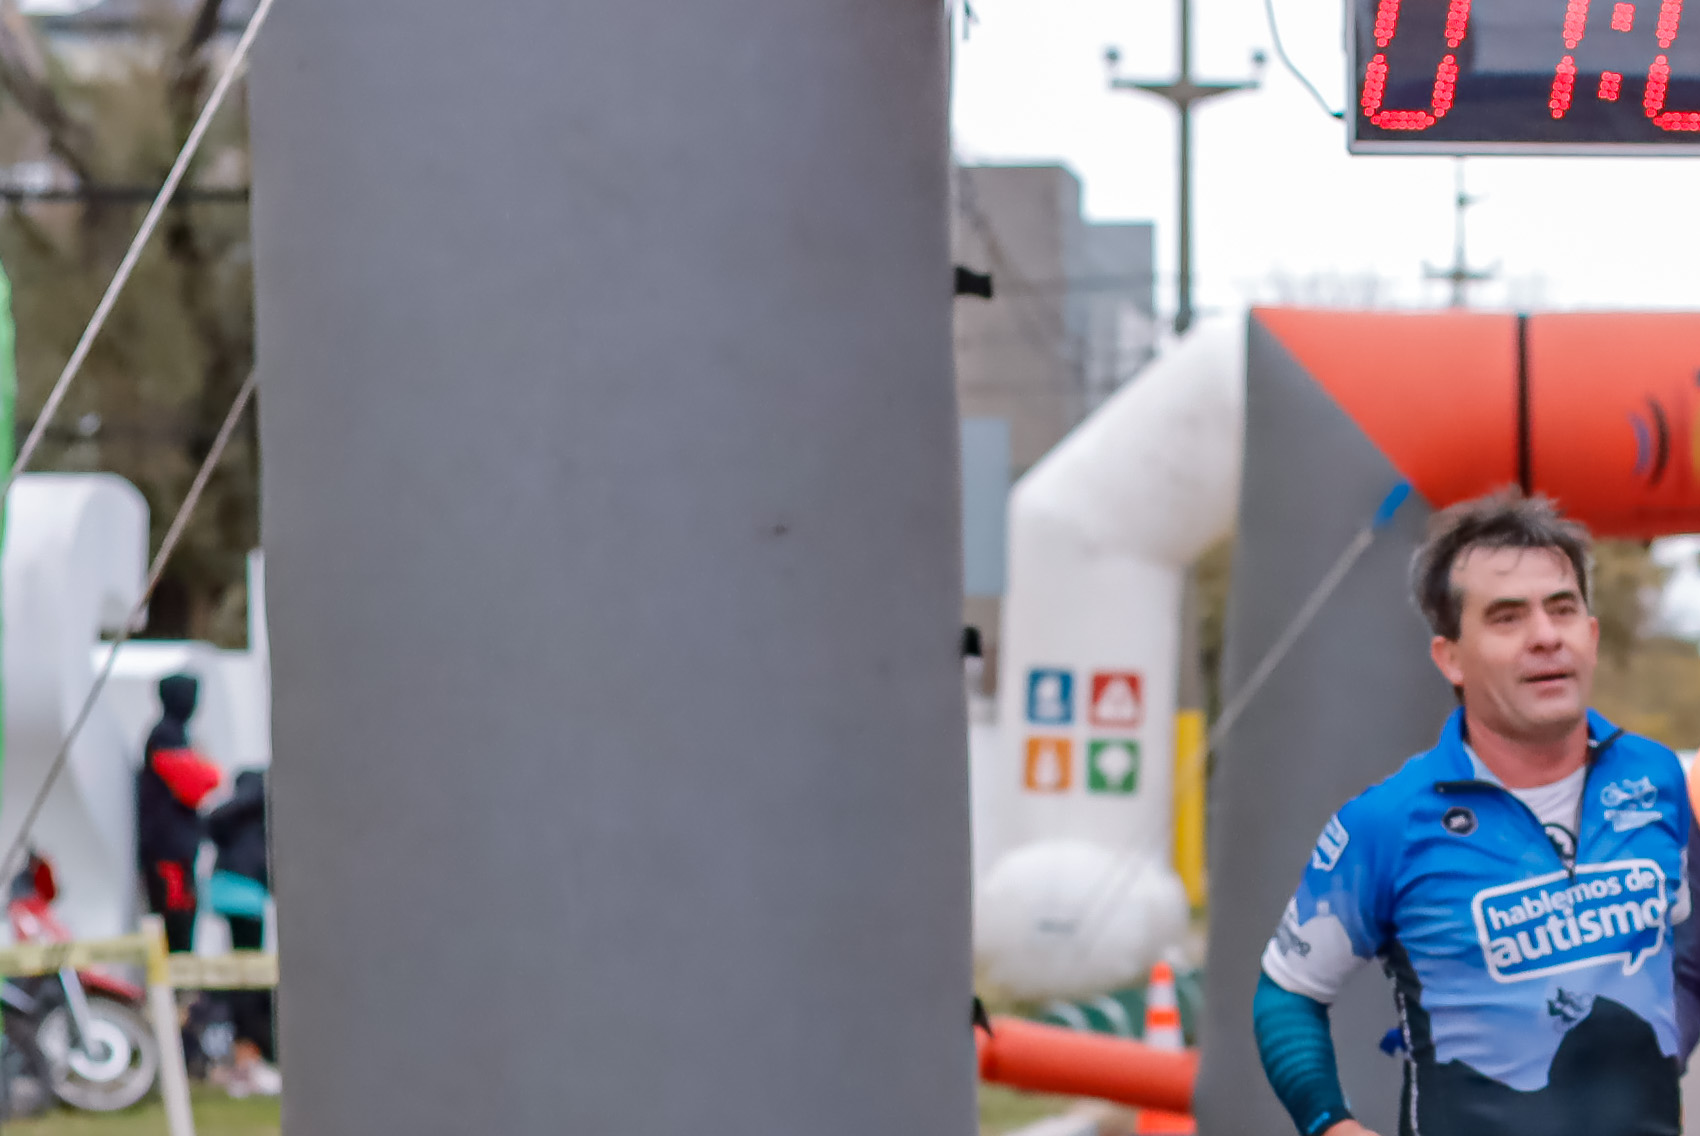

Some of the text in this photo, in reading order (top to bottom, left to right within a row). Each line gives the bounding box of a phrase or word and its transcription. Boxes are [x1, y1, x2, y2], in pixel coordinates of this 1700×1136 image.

[1487, 866, 1655, 931] hablemos de
[1489, 897, 1667, 968] autismo
